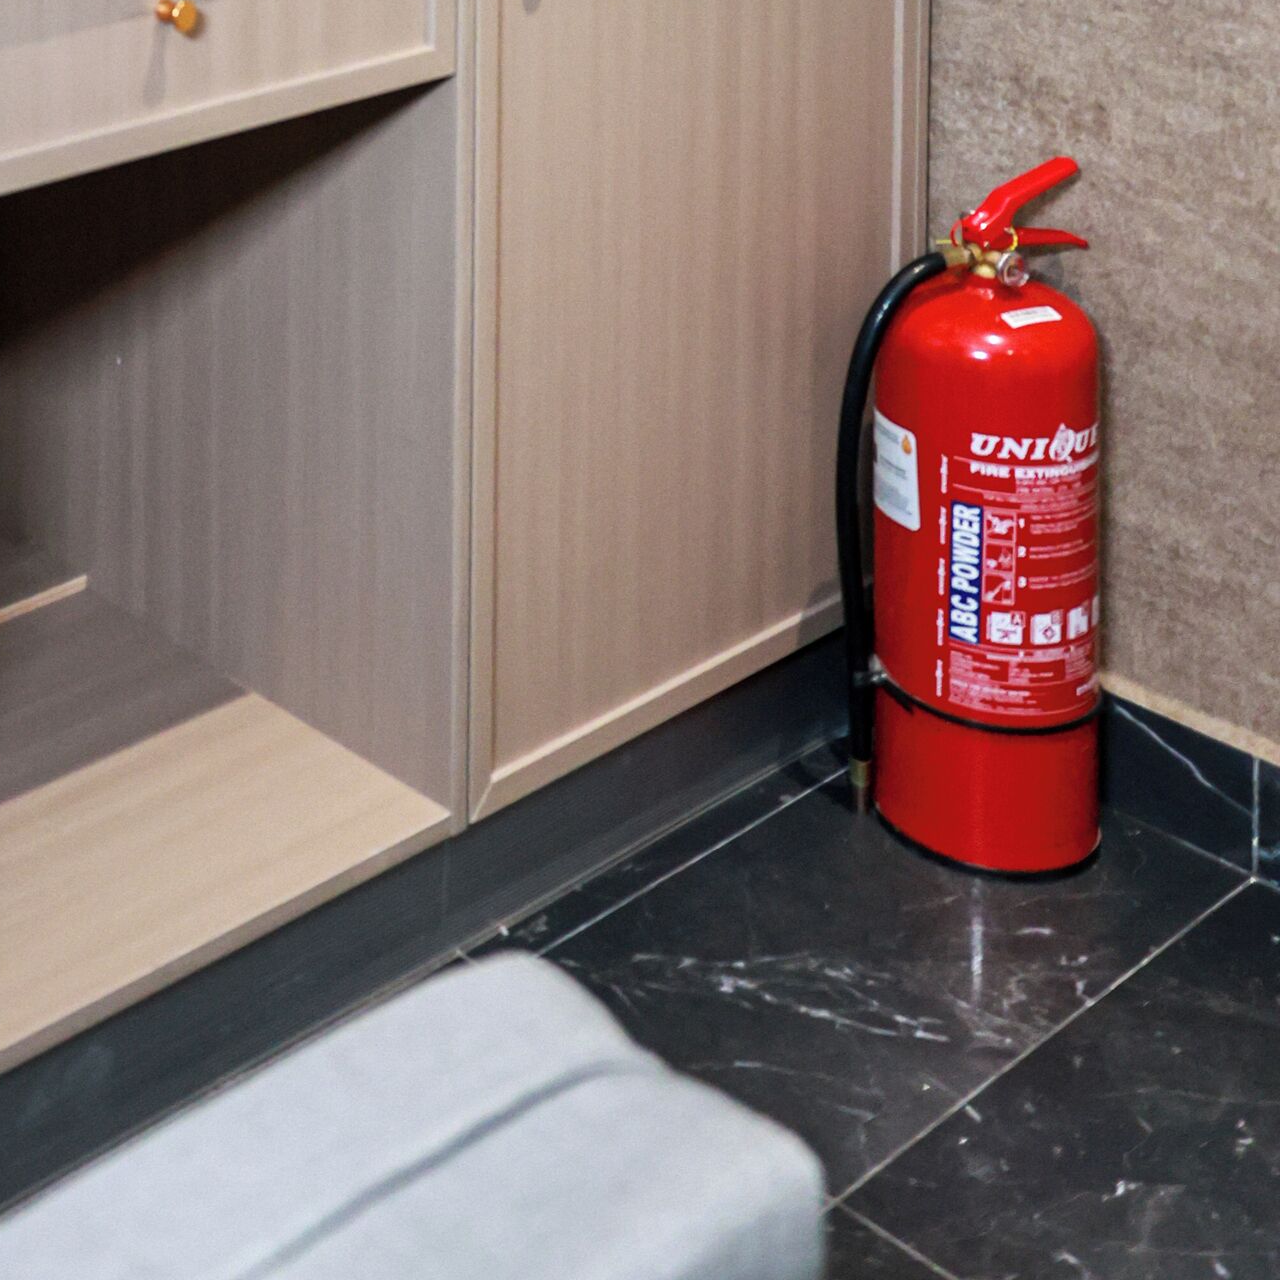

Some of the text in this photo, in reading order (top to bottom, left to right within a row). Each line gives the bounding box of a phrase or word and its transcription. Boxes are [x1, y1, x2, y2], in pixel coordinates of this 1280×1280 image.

[970, 460, 1010, 479] FIRE
[1013, 449, 1099, 480] EXTINGU
[951, 503, 981, 594] POWDER
[950, 593, 979, 644] ABC
